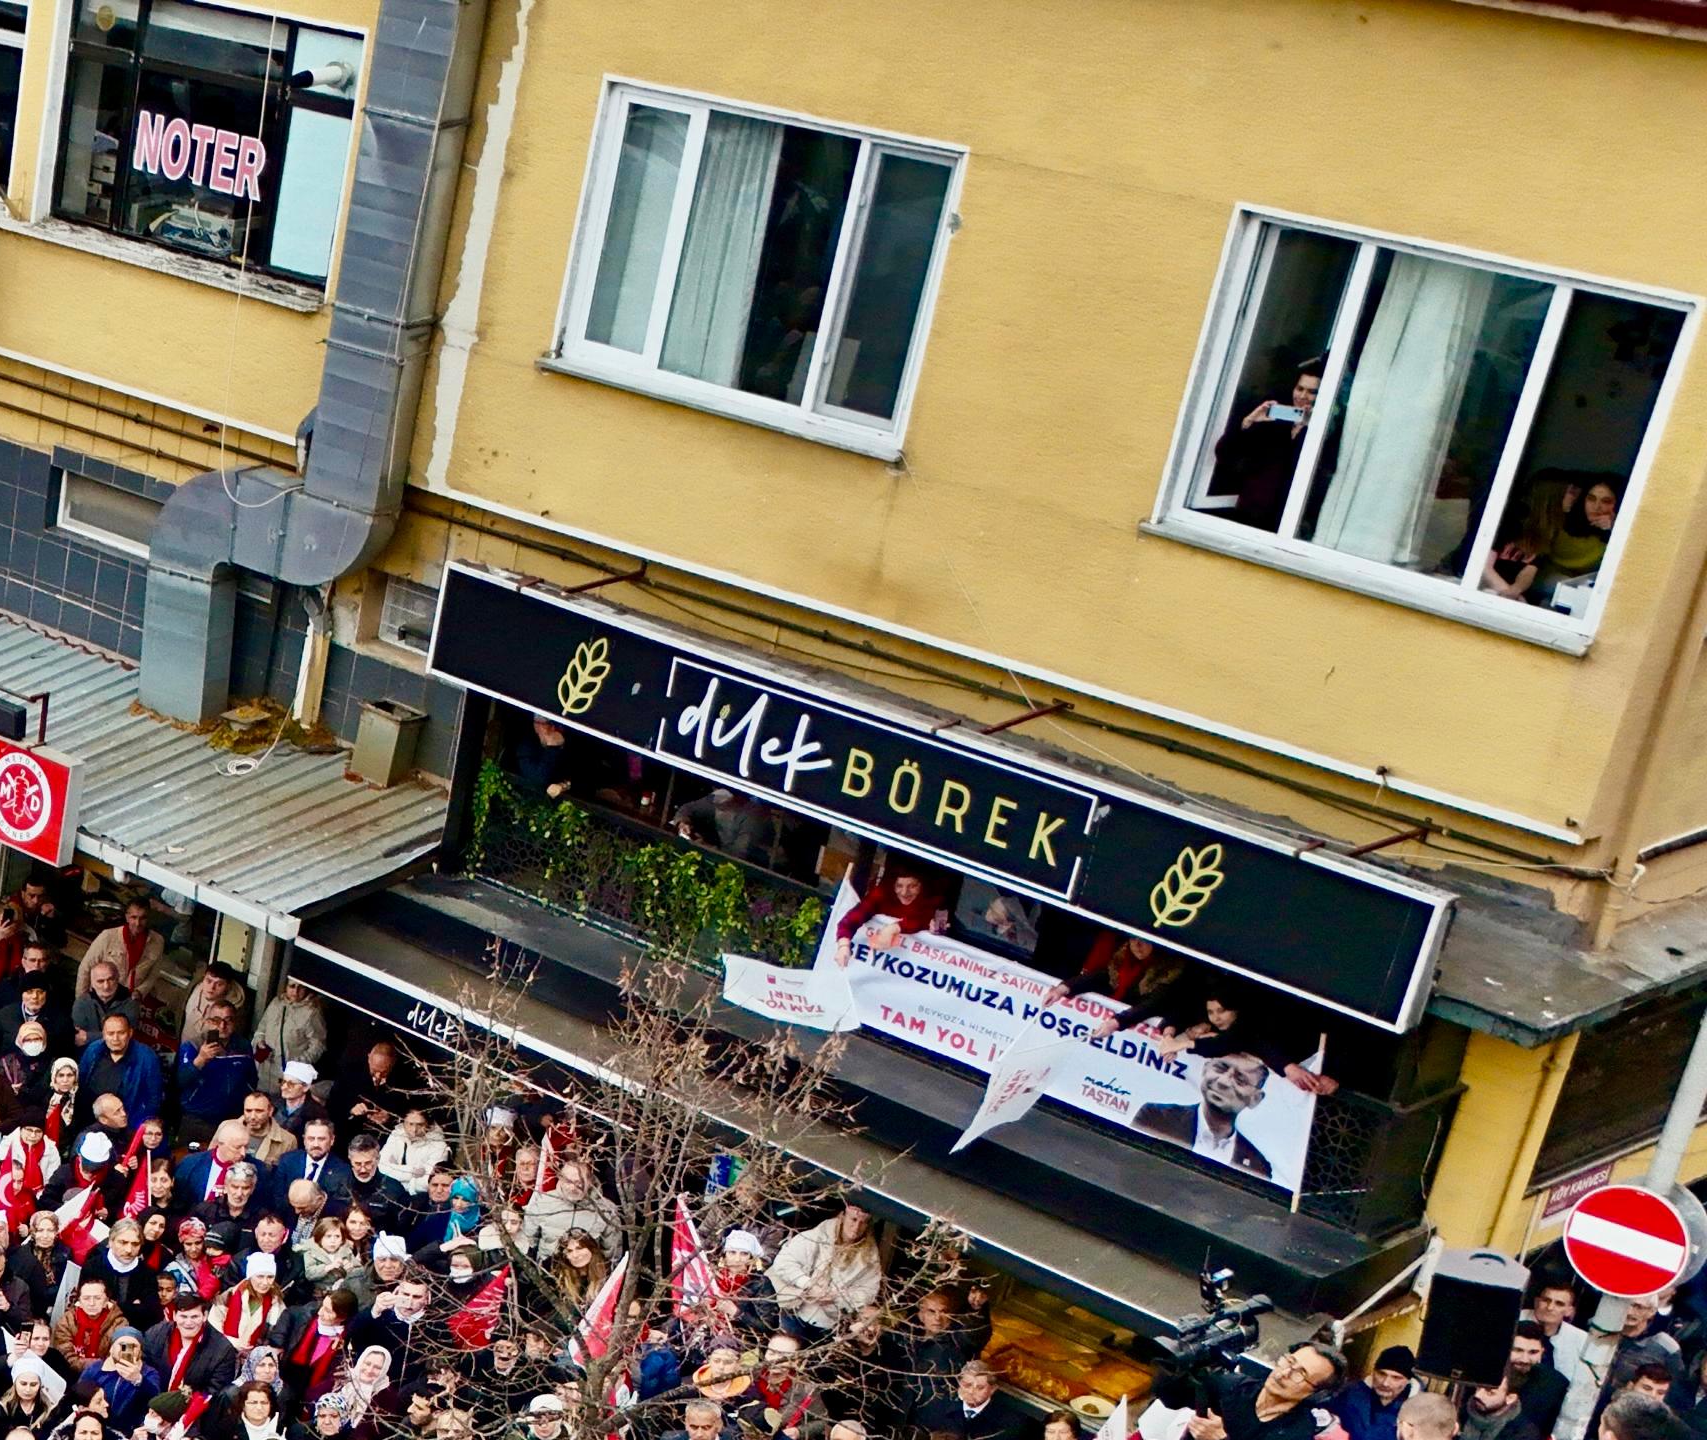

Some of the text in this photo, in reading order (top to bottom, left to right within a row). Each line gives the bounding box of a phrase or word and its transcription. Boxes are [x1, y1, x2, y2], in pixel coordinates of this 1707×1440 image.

[132, 109, 268, 202] NOTER
[0, 781, 41, 812] M D
[677, 676, 1066, 868] dilek BÖREK
[912, 941, 998, 980] BAŞKANIMIZ
[1001, 972, 1045, 997] SAYIN
[879, 1004, 927, 1036] TAM
[936, 1026, 978, 1057] YOL
[1080, 1083, 1131, 1113] TAŞTAN
